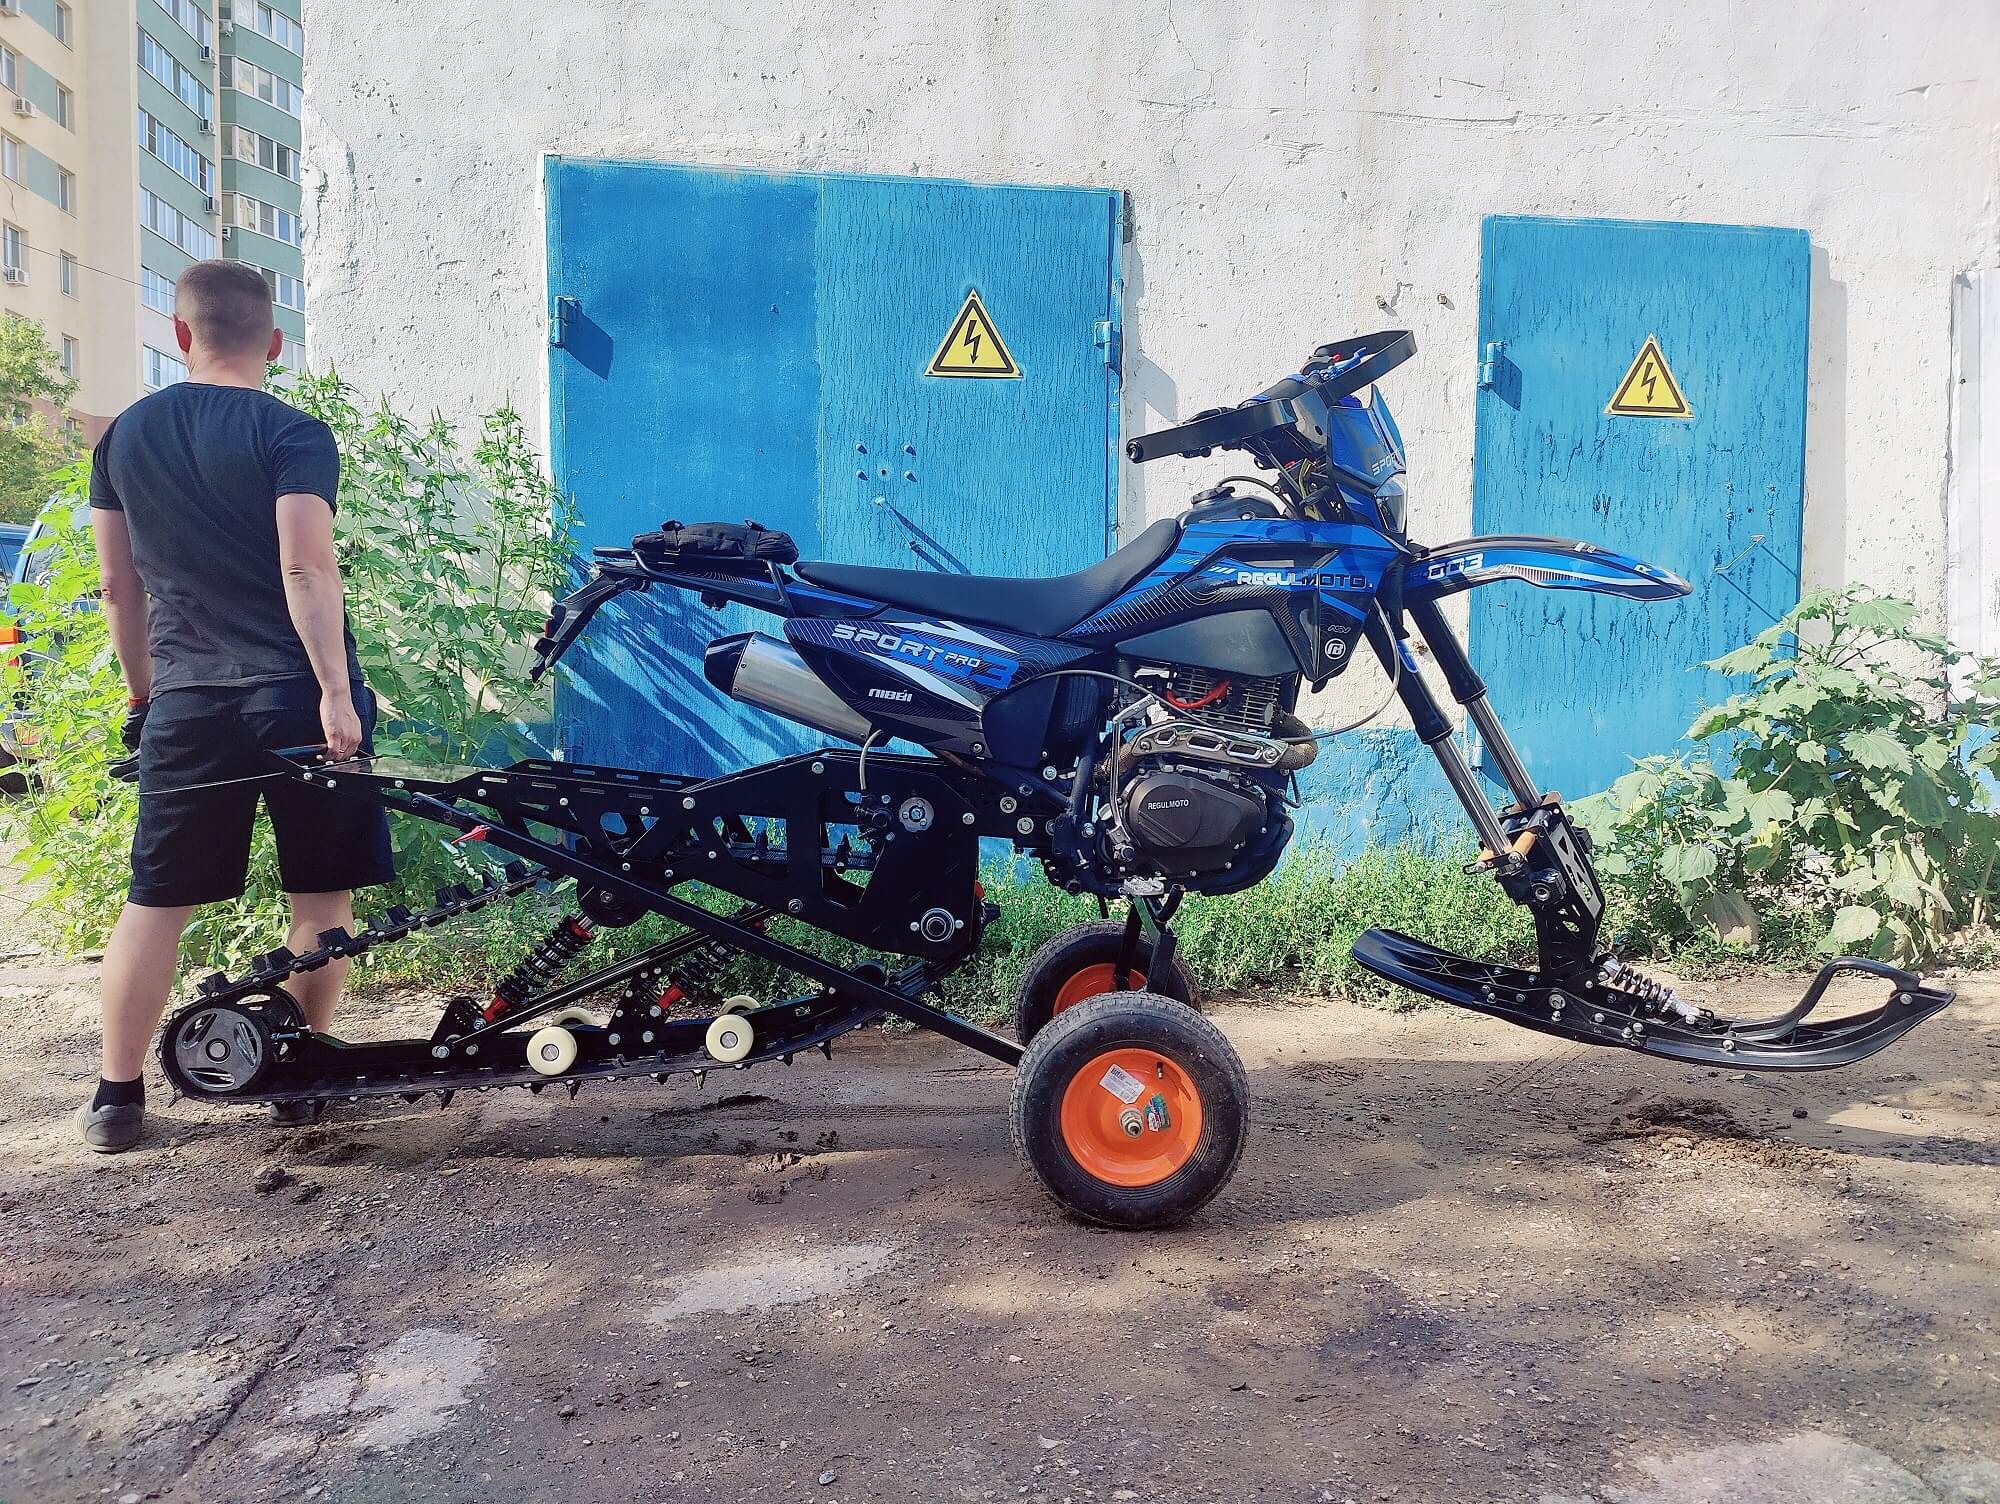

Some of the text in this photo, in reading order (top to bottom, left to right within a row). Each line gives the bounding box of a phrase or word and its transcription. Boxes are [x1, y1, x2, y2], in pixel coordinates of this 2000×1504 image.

[1236, 571, 1367, 589] REGULMOTO
[831, 624, 981, 668] SPORT PRO
[1147, 799, 1190, 810] REGULMOTO
